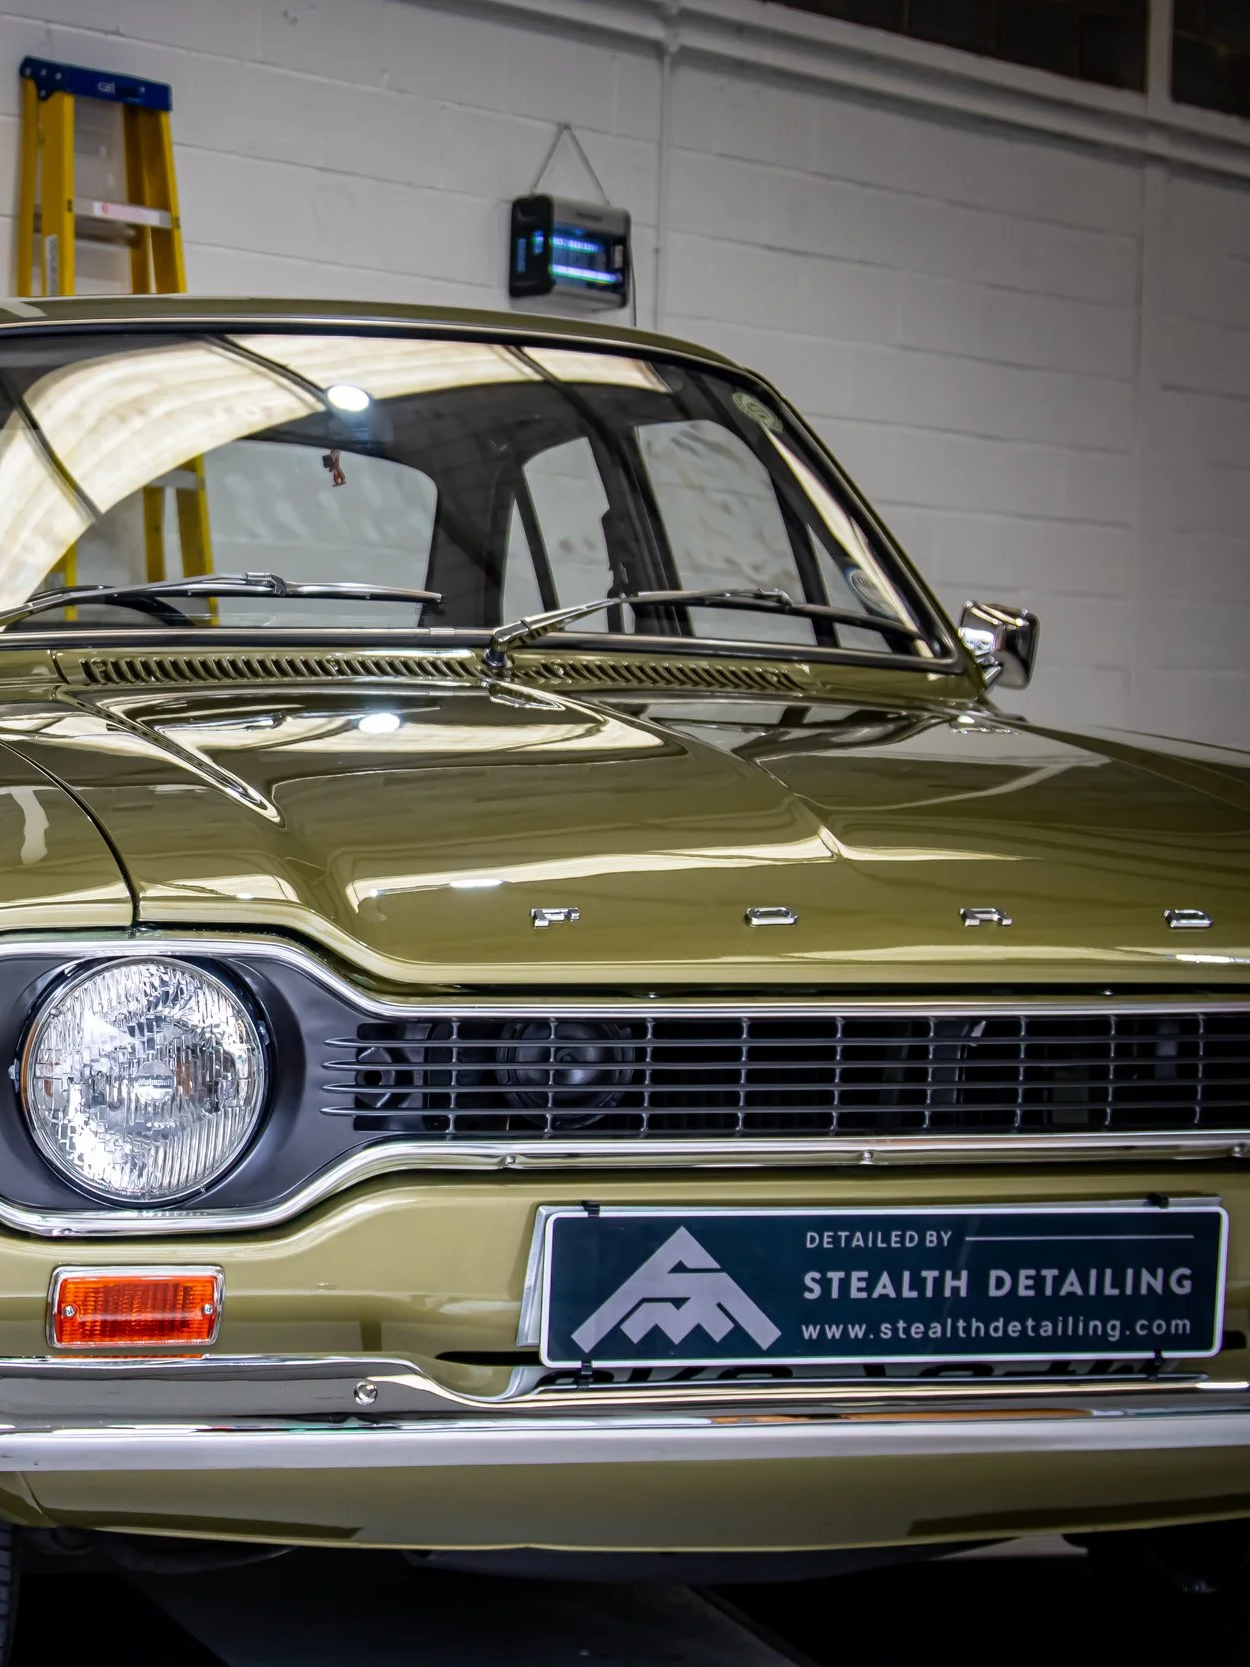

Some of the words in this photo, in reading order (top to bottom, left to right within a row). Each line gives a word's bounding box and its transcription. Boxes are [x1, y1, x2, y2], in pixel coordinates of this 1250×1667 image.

[806, 1231, 919, 1248] DETAILED
[925, 1231, 953, 1247] BY
[803, 1270, 968, 1300] STEALTH
[988, 1267, 1193, 1297] DETAILING
[801, 1316, 1191, 1341] www.stealthdetailing.com
